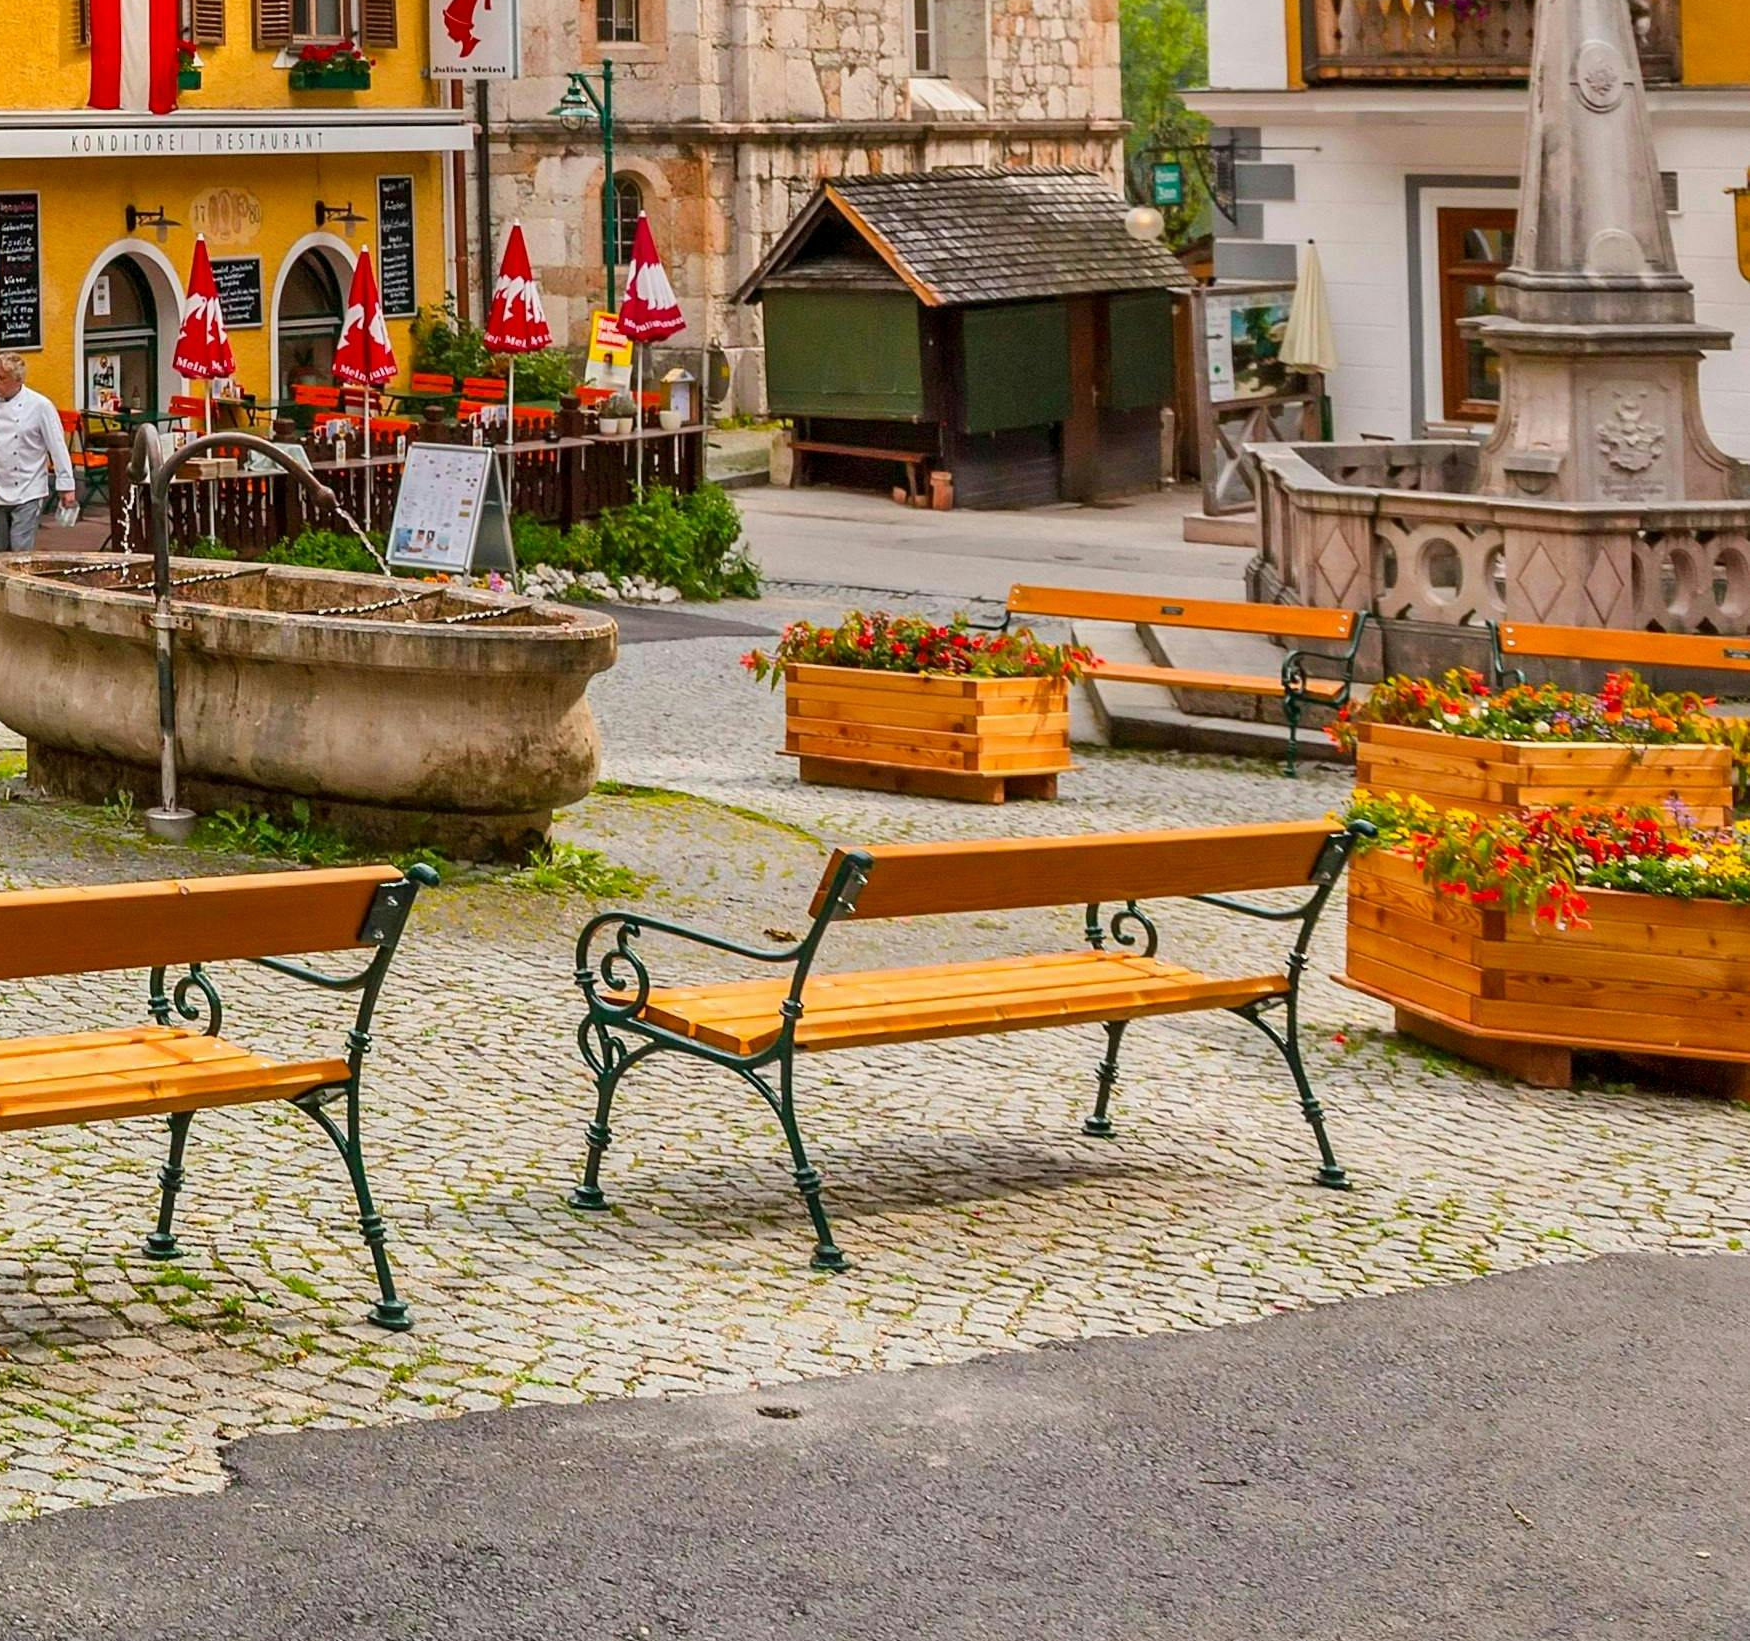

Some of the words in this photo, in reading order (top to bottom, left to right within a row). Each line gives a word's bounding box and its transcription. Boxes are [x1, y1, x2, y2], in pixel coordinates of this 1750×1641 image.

[433, 65, 468, 73] Julius
[472, 65, 506, 73] Meinl
[71, 134, 184, 153] KONDITOREI
[216, 132, 324, 151] RESTAURANT
[176, 357, 208, 374] Mein
[340, 364, 367, 381] Mein
